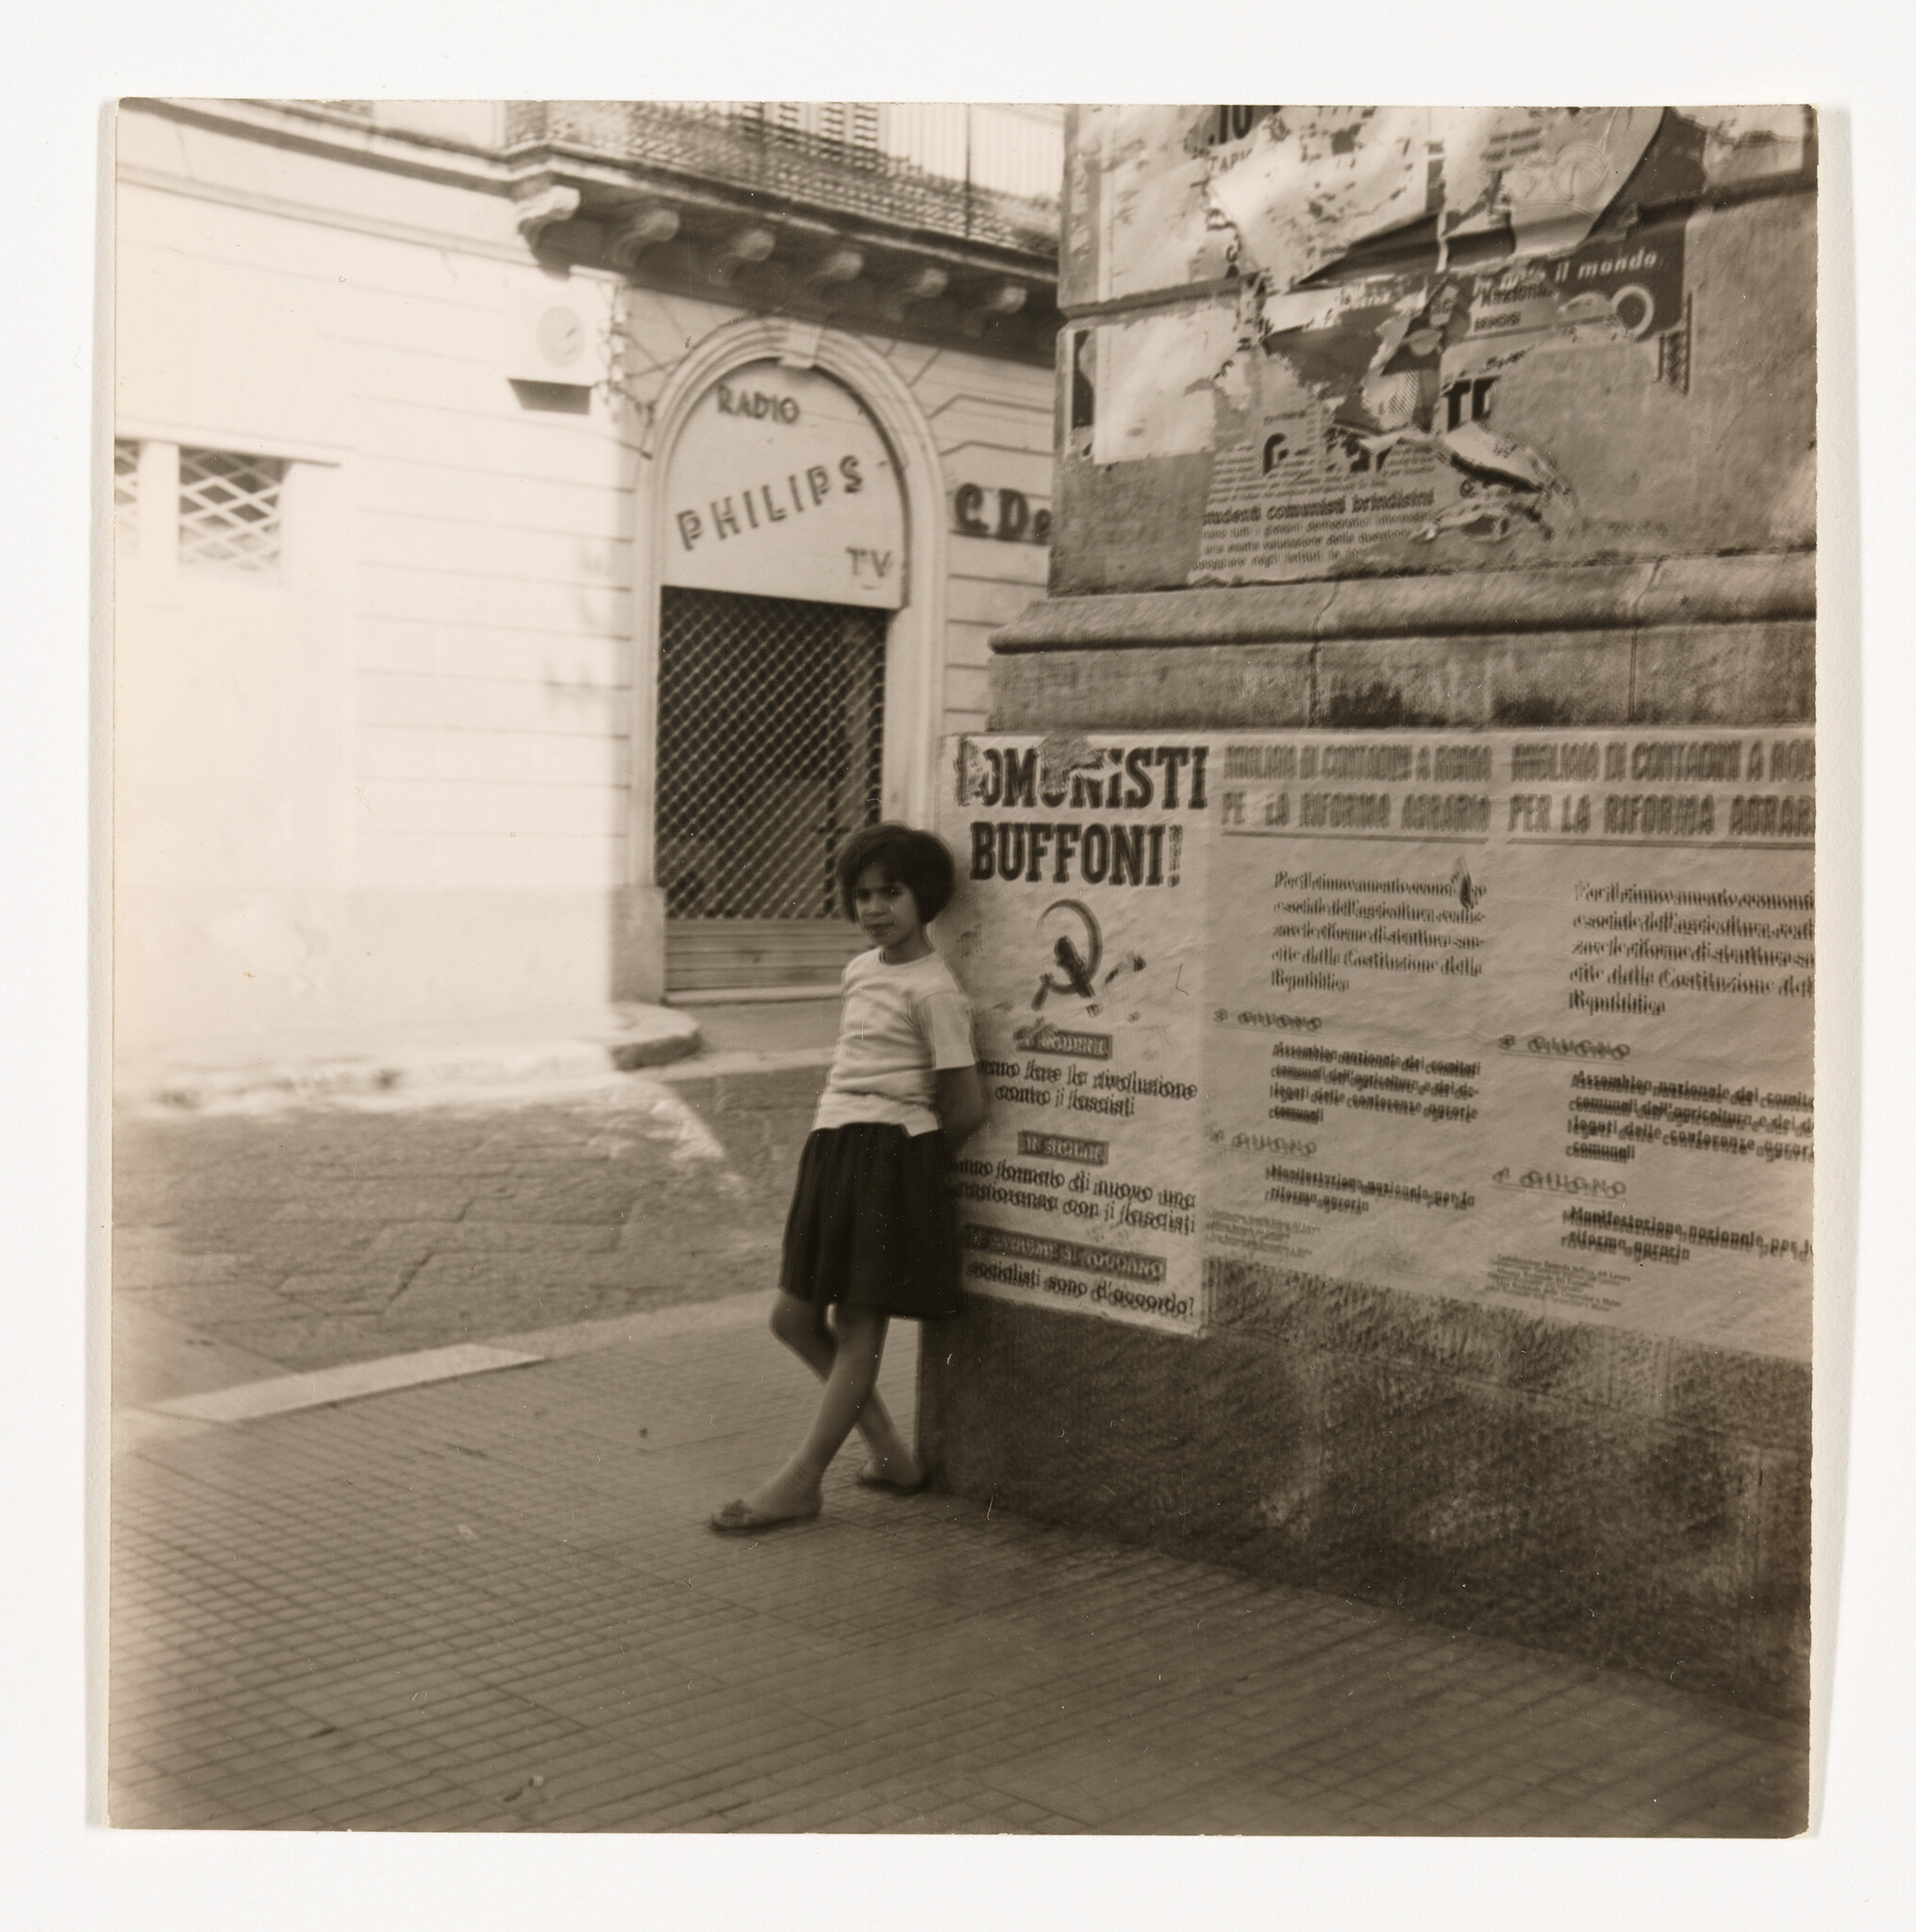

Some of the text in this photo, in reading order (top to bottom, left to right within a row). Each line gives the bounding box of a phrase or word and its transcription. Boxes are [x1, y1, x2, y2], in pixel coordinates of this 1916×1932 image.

[1576, 248, 1658, 280] mondo
[715, 383, 801, 425] RADIO
[675, 455, 864, 552] PHILIPS
[1266, 495, 1347, 520] comunisti
[1263, 519, 1301, 539] giovani
[845, 547, 892, 579] TV
[1508, 792, 1554, 834] PER
[1559, 792, 1591, 835] LA
[1603, 793, 1716, 836] RIFORMA
[969, 820, 1183, 888] BUFFONI!
[1343, 948, 1439, 975] Costituzione
[1440, 955, 1484, 977] della
[1271, 968, 1350, 992] Repubblica
[1607, 963, 1655, 988] dalla
[1658, 967, 1774, 996] Costituzione
[1567, 989, 1666, 1017] Repubblica
[1271, 1040, 1338, 1063] Assemblea
[1337, 1048, 1401, 1070] nazionale
[1527, 1035, 1631, 1062] GIUGNO
[1024, 1059, 1062, 1083] fare
[1067, 1063, 1088, 1087] la
[1092, 1068, 1198, 1101] rivoluzione
[1270, 1063, 1325, 1081] comunali
[1570, 1070, 1653, 1096] Assemblea
[1652, 1077, 1730, 1105] nazionale
[994, 1084, 1052, 1107] contro
[1067, 1088, 1136, 1118] fascisti
[1268, 1105, 1325, 1125] comunali
[1567, 1092, 1638, 1118] comunali
[1565, 1139, 1637, 1164] comunali
[1566, 1114, 1618, 1140] legati
[1617, 1121, 1662, 1145] delle
[1661, 1124, 1757, 1157] conferenze
[995, 1158, 1065, 1191] formato
[1068, 1170, 1091, 1193] di
[1092, 1178, 1153, 1204] nuovo
[1158, 1187, 1197, 1209] una
[1264, 1163, 1363, 1192] Manifestazione
[1519, 1170, 1626, 1199] GIUGNO
[1062, 1198, 1101, 1219] con
[1119, 1203, 1197, 1238] fascisti
[1561, 1205, 1684, 1241] Manifestazione
[1678, 1223, 1764, 1253] nazionale
[1560, 1228, 1691, 1267] riforma agraria
[967, 1258, 1196, 1318] socialisti sono d'accordo!
